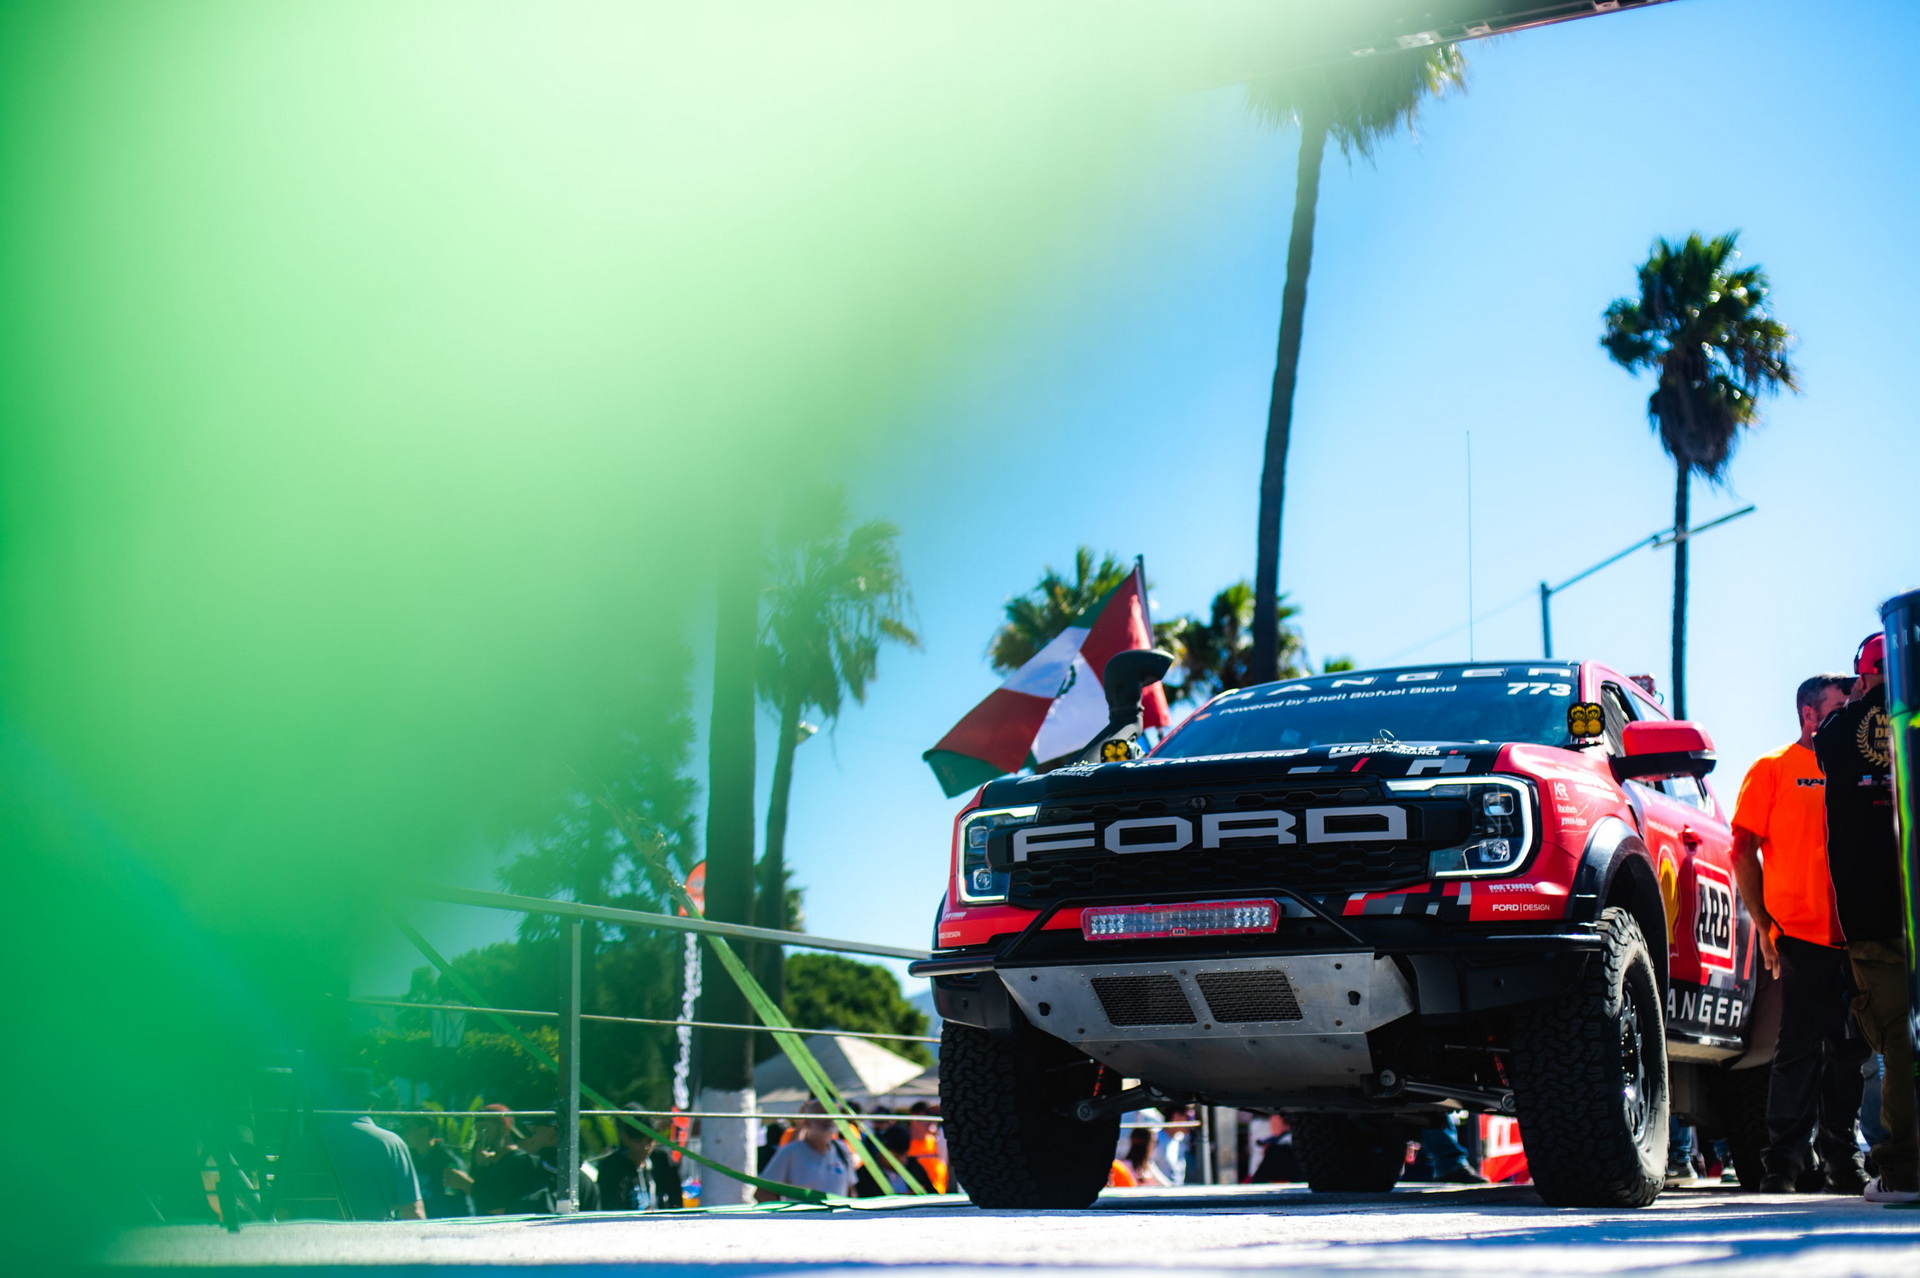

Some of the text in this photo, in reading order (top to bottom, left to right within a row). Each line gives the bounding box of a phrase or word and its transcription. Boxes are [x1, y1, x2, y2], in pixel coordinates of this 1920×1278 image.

[1507, 682, 1571, 697] 773
[1219, 685, 1457, 716] Powered by Shell Biofuel Blend
[1357, 747, 1441, 756] PERFORMANCE
[1014, 805, 1407, 862] FORD
[1489, 883, 1534, 891] METHOD
[1492, 904, 1519, 912] FORD
[1696, 884, 1730, 949] ARB
